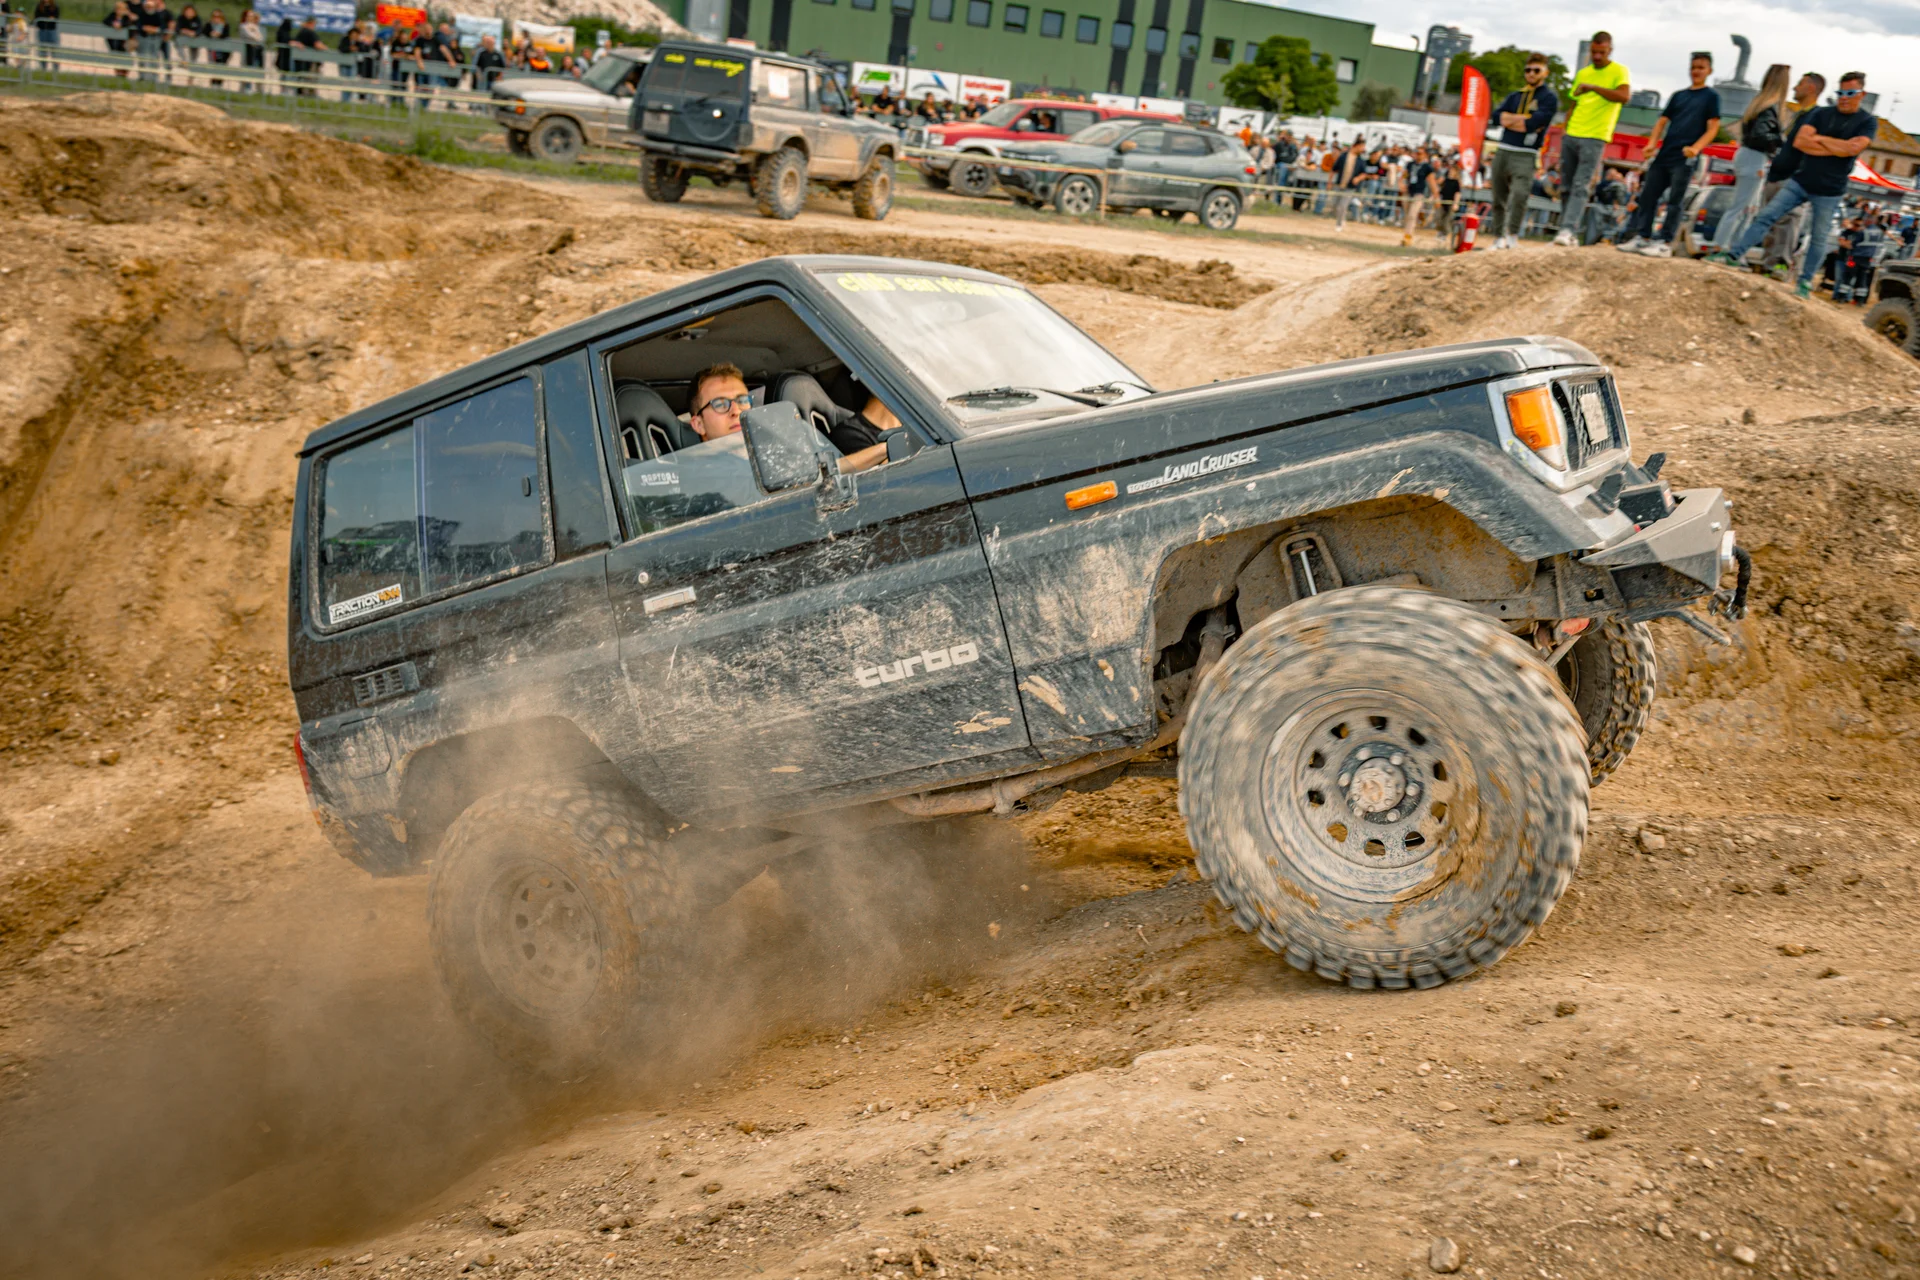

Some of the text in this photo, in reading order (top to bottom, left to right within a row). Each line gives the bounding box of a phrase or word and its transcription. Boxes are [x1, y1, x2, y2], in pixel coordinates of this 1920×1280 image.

[837, 272, 896, 293] club
[894, 277, 941, 293] san
[1128, 477, 1163, 494] TOYOTA
[854, 642, 979, 689] turbo
